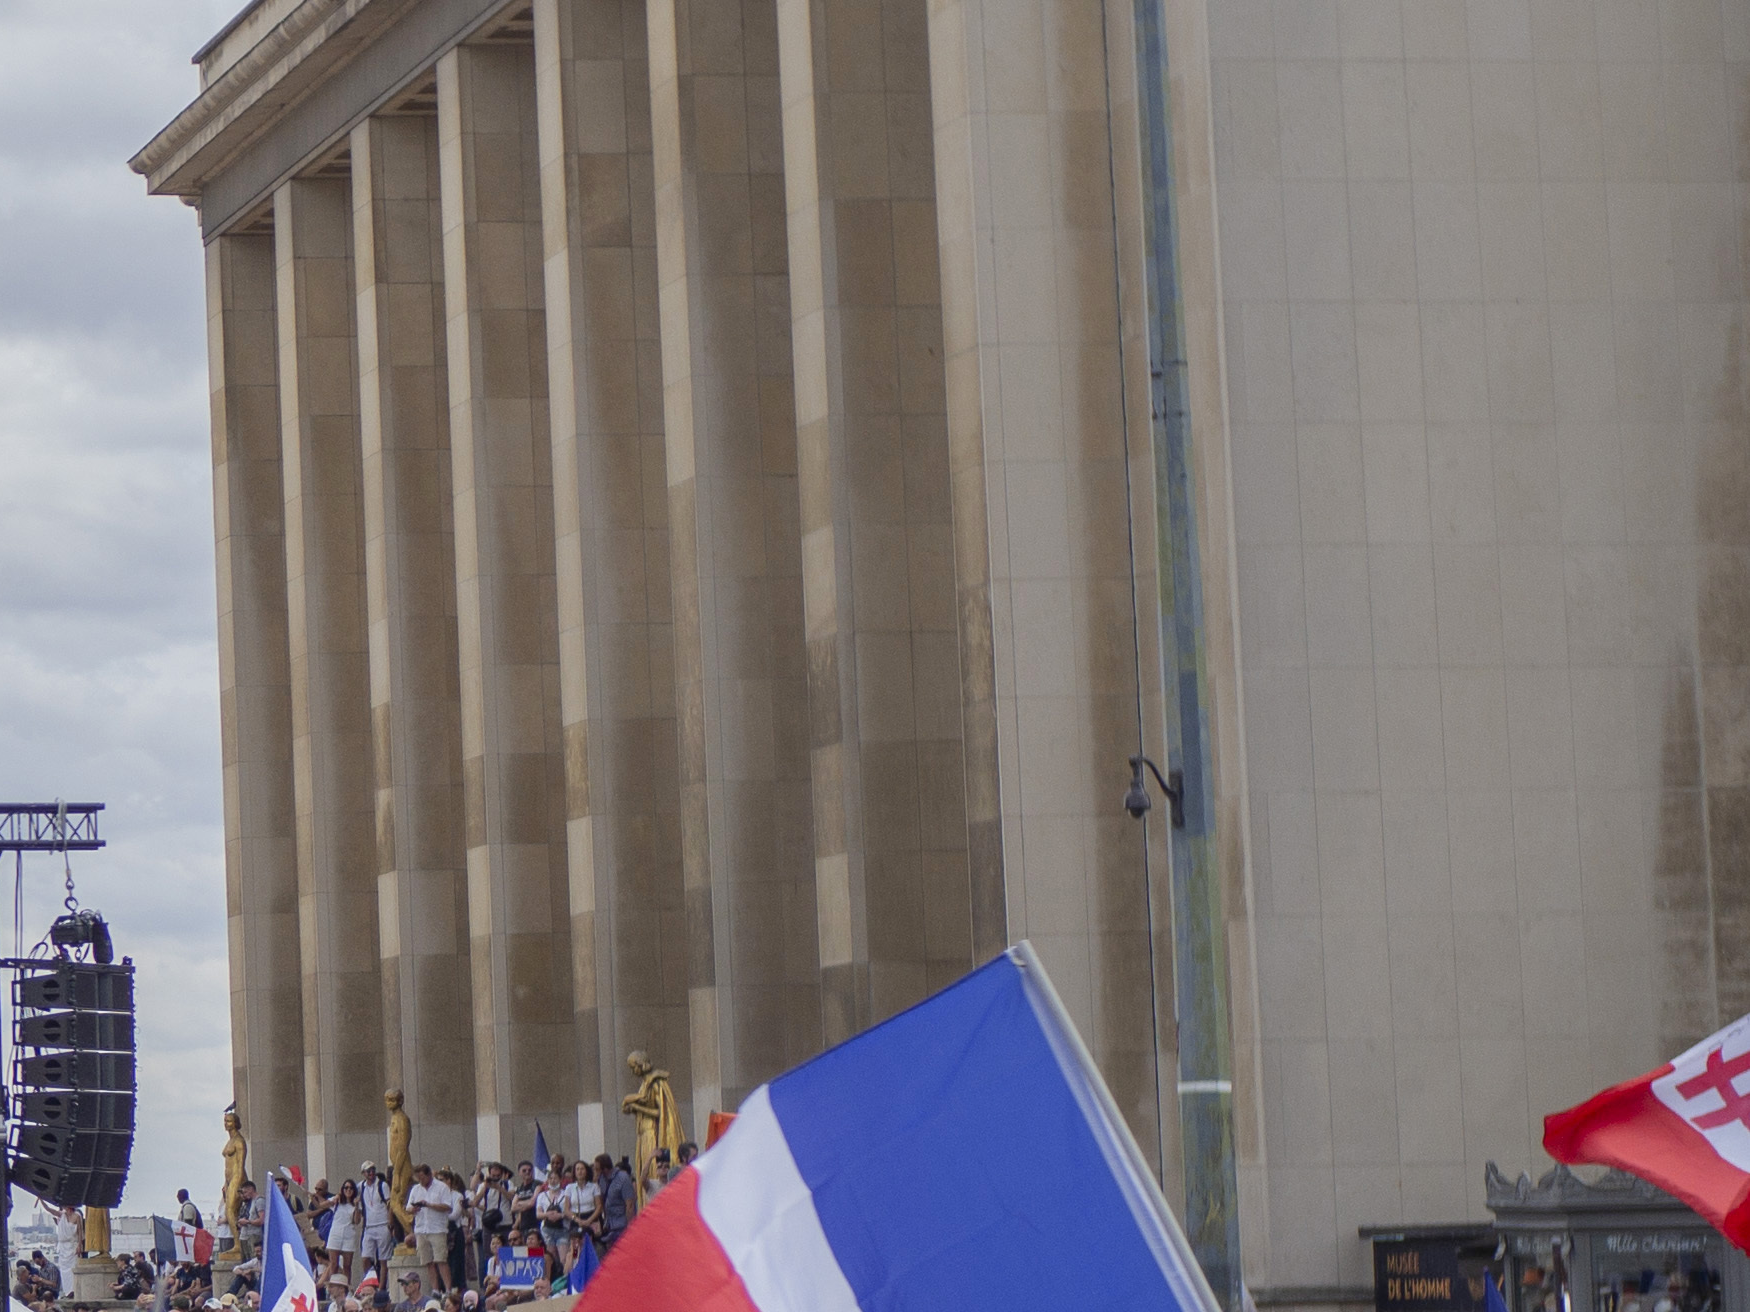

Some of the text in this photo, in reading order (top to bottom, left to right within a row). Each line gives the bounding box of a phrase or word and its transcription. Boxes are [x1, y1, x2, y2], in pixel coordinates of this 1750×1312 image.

[1386, 1251, 1420, 1275] MUSÉE
[1388, 1278, 1451, 1301] DE L'HOMME
